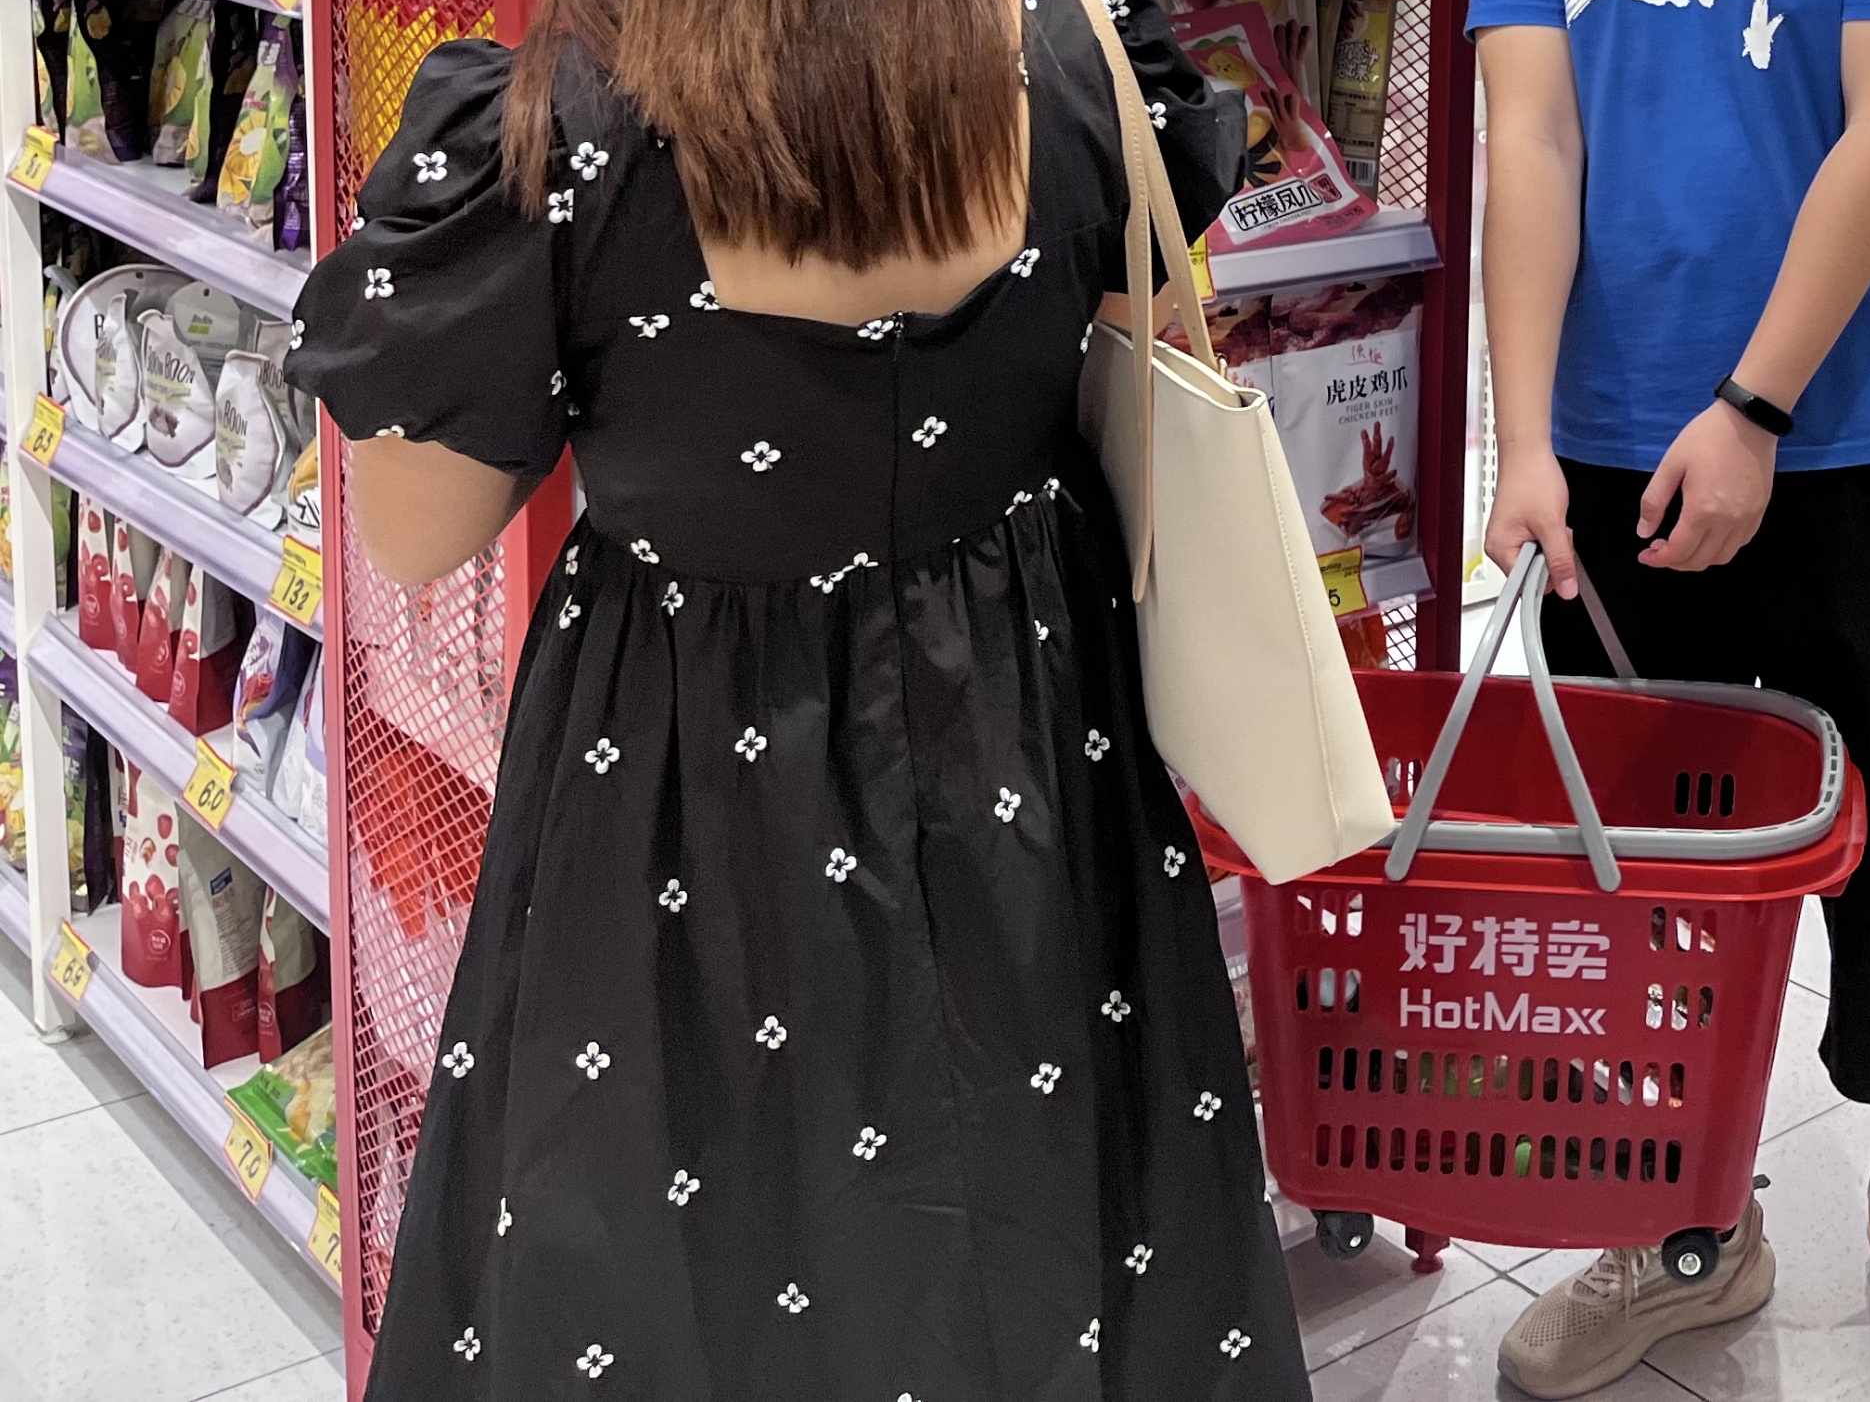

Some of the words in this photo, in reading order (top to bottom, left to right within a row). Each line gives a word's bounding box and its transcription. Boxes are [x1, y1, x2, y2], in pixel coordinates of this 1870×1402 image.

[1235, 184, 1320, 226] 柠檬凤爪
[1326, 365, 1409, 406] 虎皮鸡爪
[1345, 402, 1370, 413] TIGER
[1372, 398, 1394, 409] SKIN
[1338, 412, 1377, 425] CHICKEN
[1379, 406, 1399, 418] FEET
[1400, 912, 1611, 980] 好特卖
[1400, 987, 1606, 1036] HotMaxx
